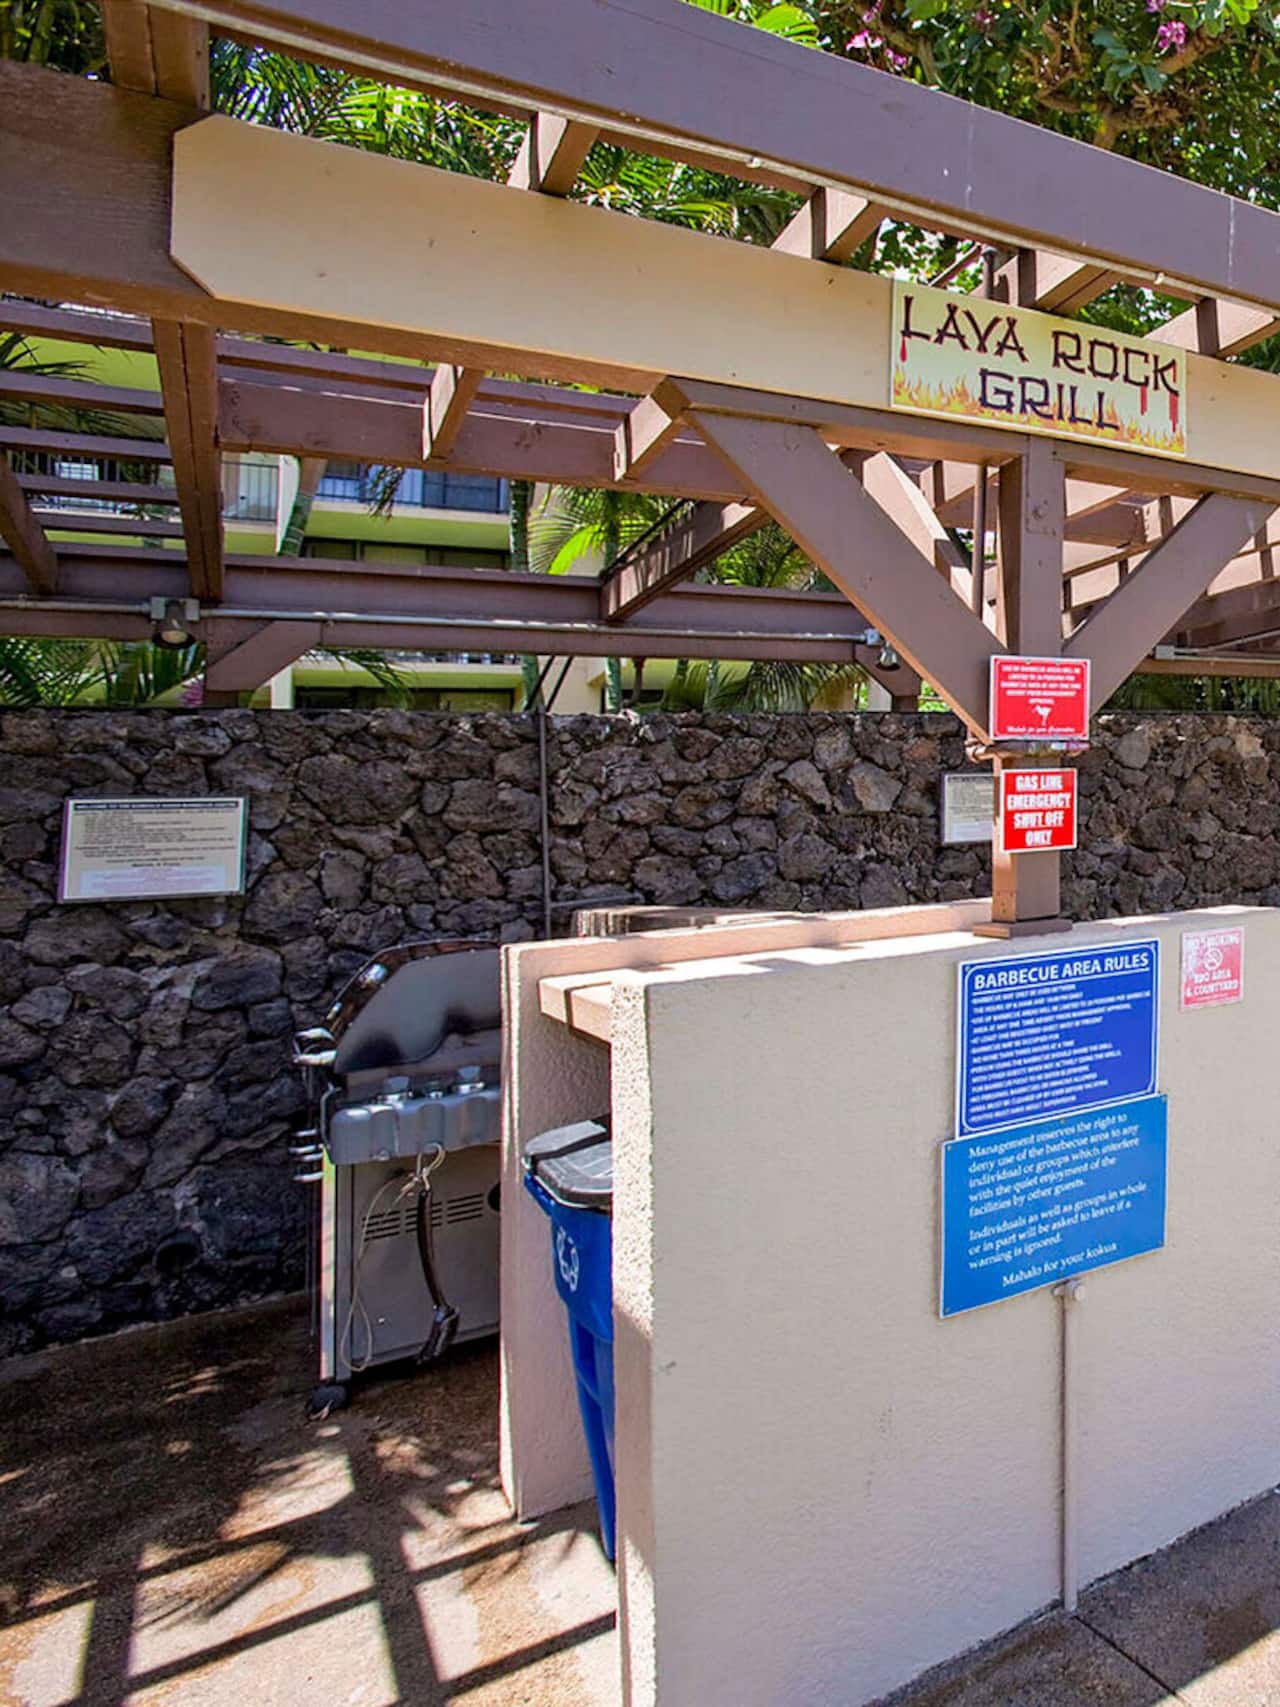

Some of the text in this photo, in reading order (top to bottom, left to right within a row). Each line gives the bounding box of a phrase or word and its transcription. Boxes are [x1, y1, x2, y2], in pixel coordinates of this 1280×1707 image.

[901, 295, 1179, 396] LAVA ROCK
[979, 368, 1119, 430] GRILL
[1007, 793, 1070, 811] EMERGENCY
[1015, 775, 1063, 791] GAS LINE
[1014, 811, 1064, 829] SHUT OFF
[1025, 830, 1052, 846] ONLY
[974, 952, 1149, 990] BARBECUE AREA RULES
[1212, 968, 1231, 981] AREA
[968, 1160, 994, 1173] deny
[998, 1155, 1015, 1166] use
[1016, 1149, 1027, 1160] of
[1028, 1147, 1044, 1157] the
[1045, 1137, 1088, 1153] barbecue
[1111, 1128, 1121, 1137] to
[1123, 1124, 1138, 1135] any
[969, 1134, 1034, 1157] Management
[1076, 1122, 1091, 1132] the
[1093, 1115, 1115, 1129] right
[1117, 1114, 1127, 1122] to
[969, 1166, 1021, 1187] individual
[1023, 1164, 1033, 1173] or
[1035, 1155, 1069, 1173] groups
[1071, 1147, 1100, 1160] which
[969, 1156, 1116, 1202] with the quiet enjoyment of the
[969, 1199, 1011, 1216] facilities
[1012, 1195, 1025, 1206] by
[1027, 1187, 1052, 1200] other
[969, 1182, 1146, 1240] Individuals as well as groups in whole
[968, 1245, 980, 1255] or
[982, 1241, 994, 1251] in
[995, 1233, 1016, 1250] part
[1018, 1226, 1036, 1240] will
[1038, 1224, 1050, 1234] be
[1051, 1213, 1078, 1230] asked
[1080, 1212, 1090, 1221] to
[1091, 1205, 1114, 1218] leave
[1114, 1199, 1124, 1211] if
[969, 1250, 1011, 1268] warning
[1013, 1247, 1022, 1256] is
[1003, 1243, 1116, 1286] Mahalo for your kokua
